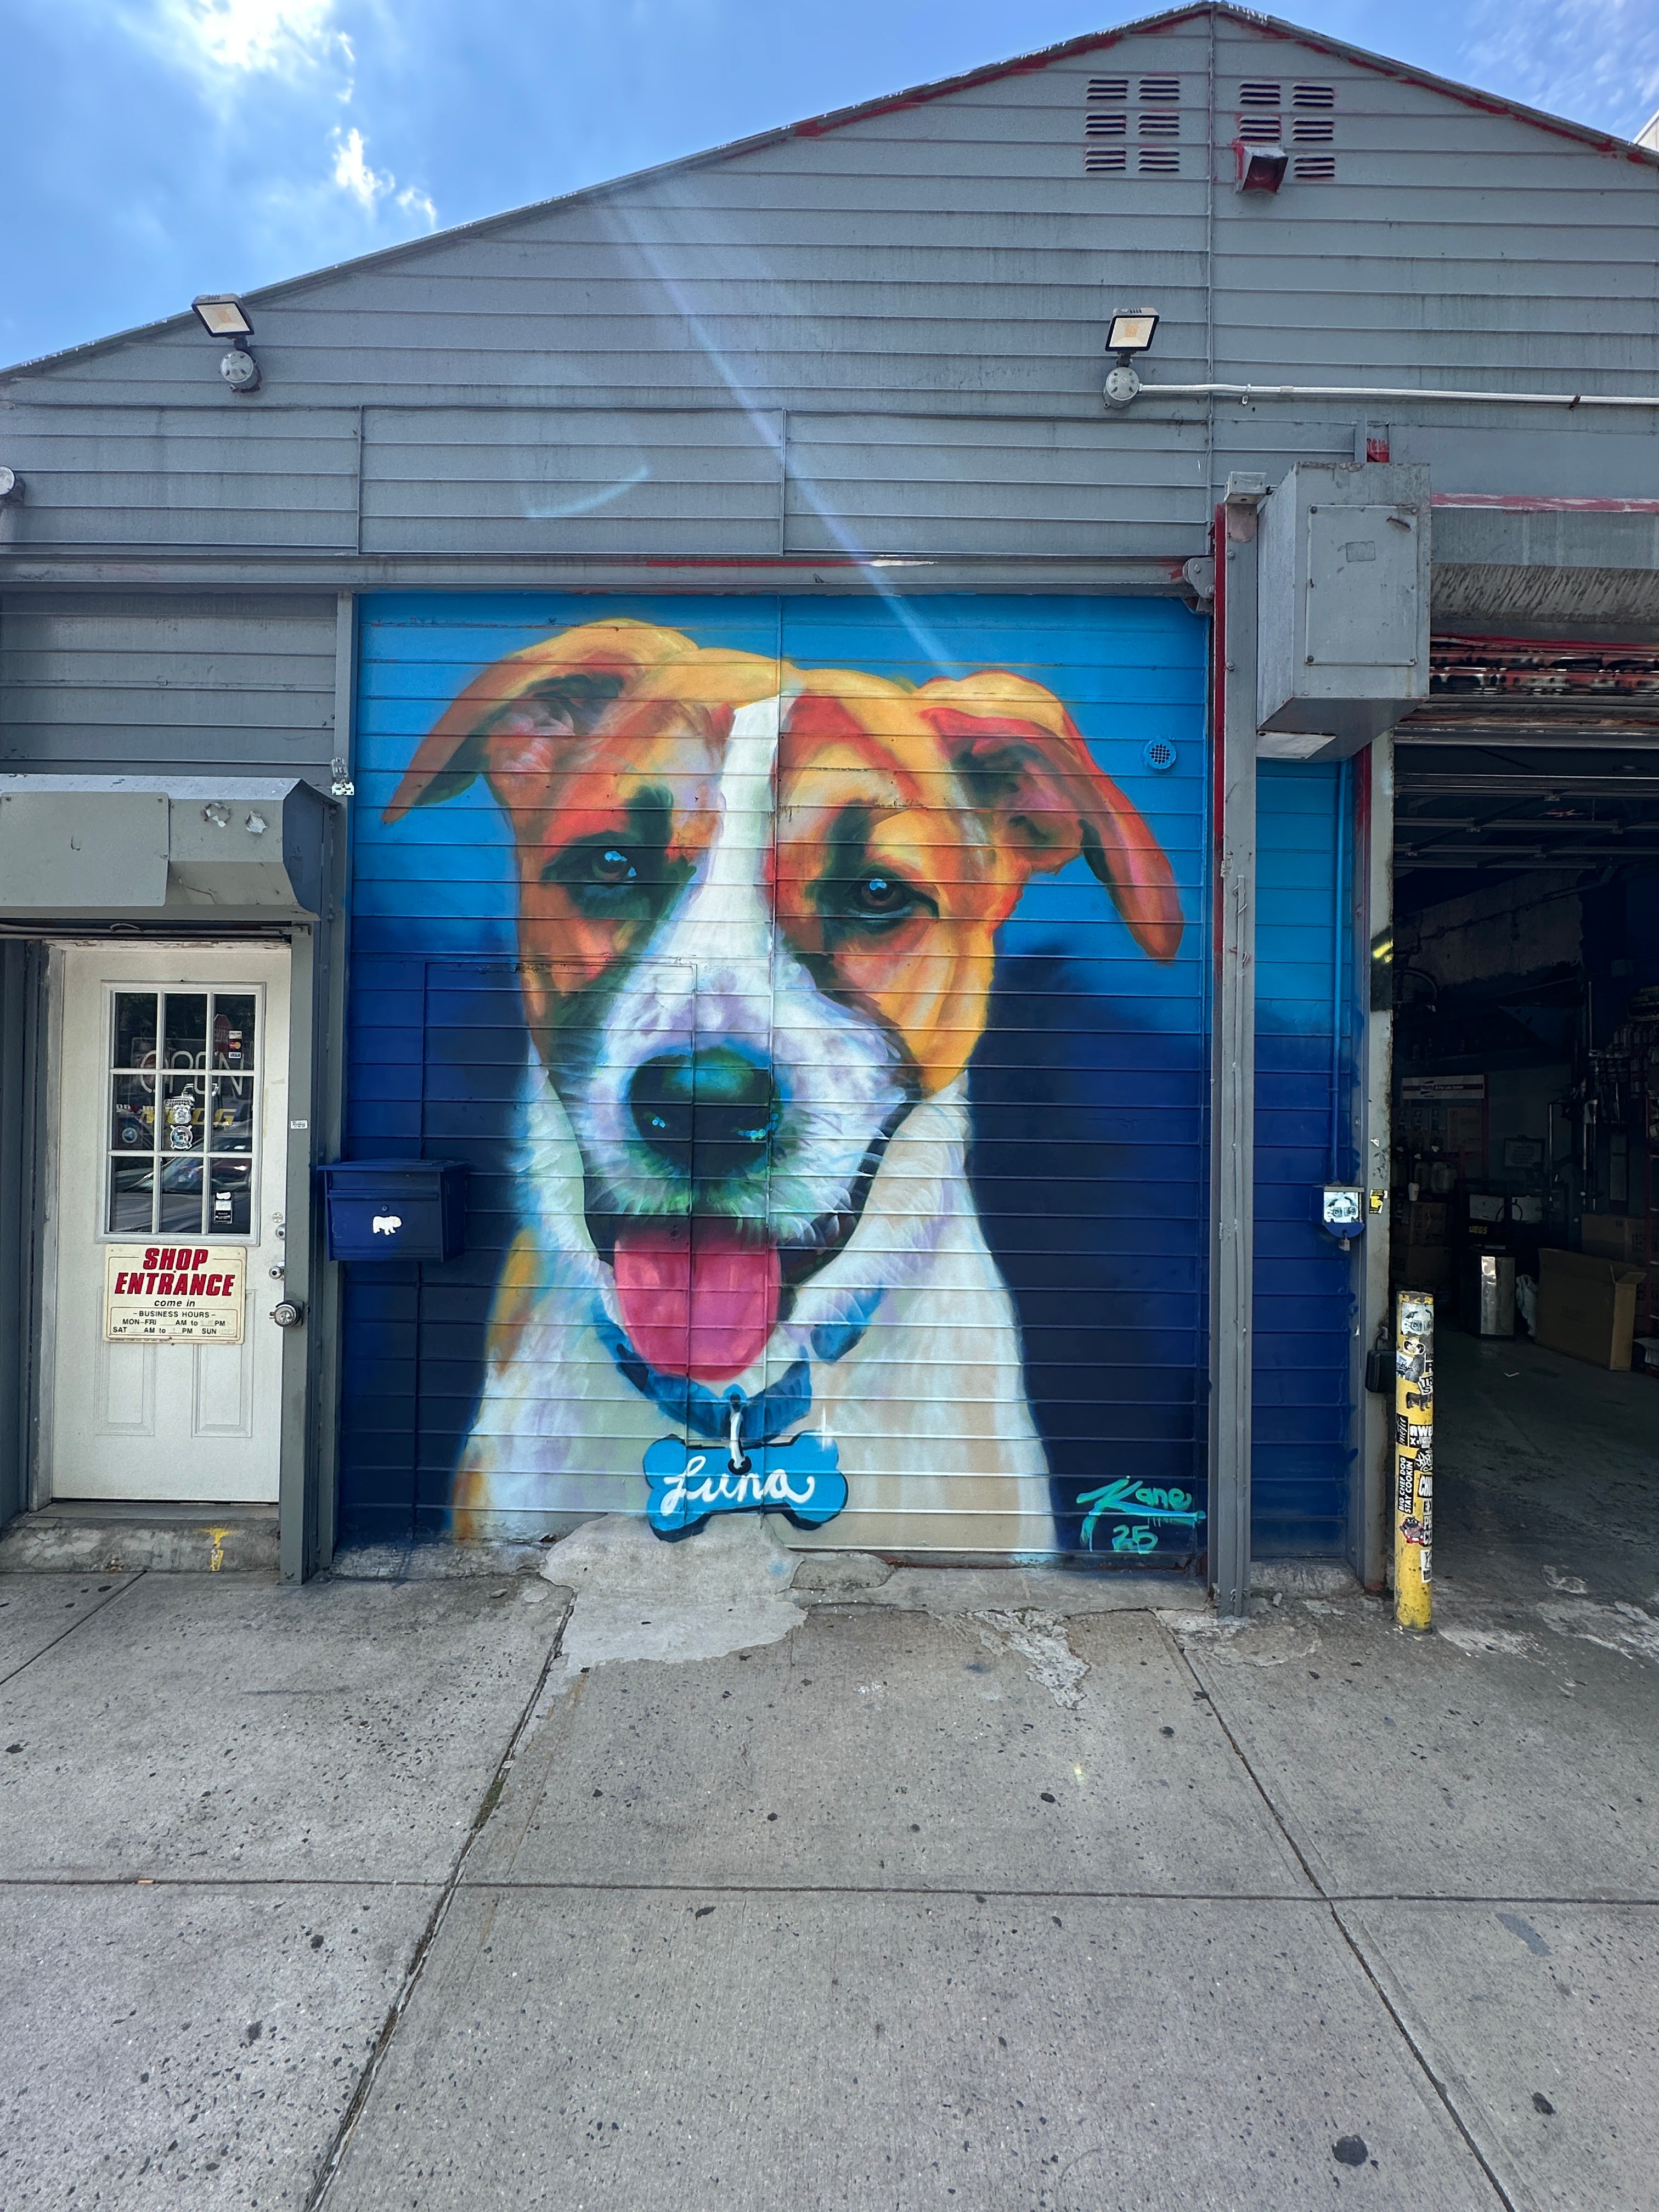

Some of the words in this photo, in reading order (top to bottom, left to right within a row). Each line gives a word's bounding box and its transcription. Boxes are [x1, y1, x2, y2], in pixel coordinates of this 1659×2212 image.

[143, 1248, 208, 1270] SHOP
[114, 1272, 235, 1296] ENTRANCE
[187, 1299, 195, 1307] in
[660, 1455, 815, 1516] Luna
[1405, 1460, 1413, 1493] COOKIN
[1076, 1478, 1206, 1544] Kane
[1112, 1524, 1158, 1554] 25
